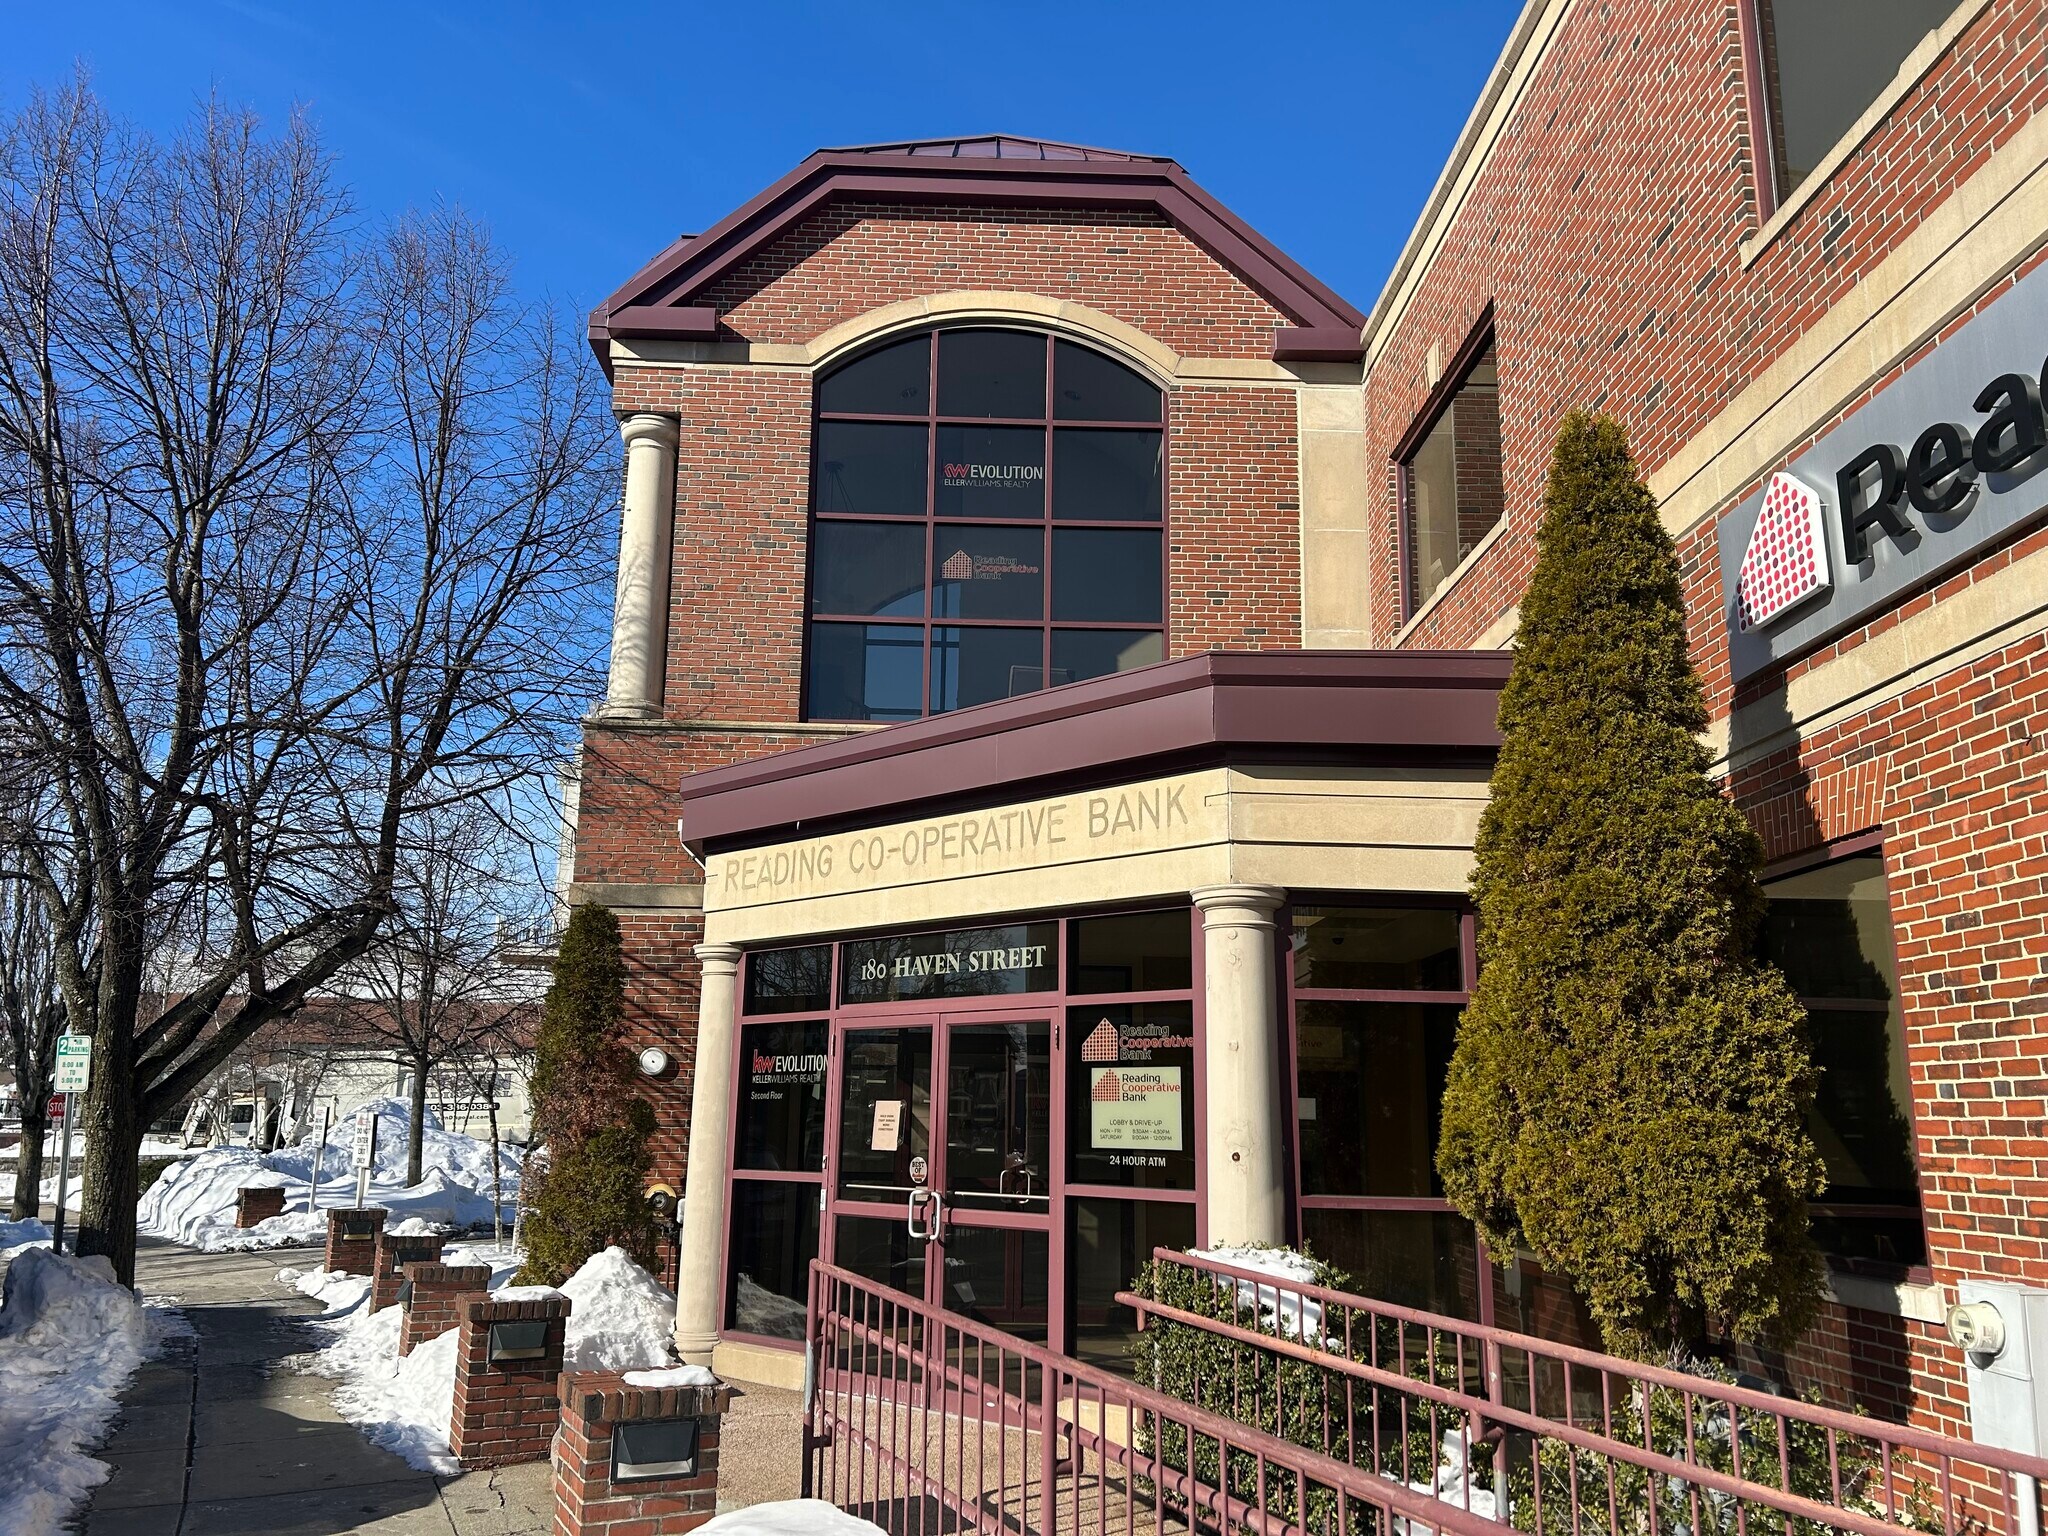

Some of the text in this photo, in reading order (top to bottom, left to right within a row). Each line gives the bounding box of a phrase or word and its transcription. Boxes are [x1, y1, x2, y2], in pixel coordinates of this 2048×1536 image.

[1836, 352, 2048, 567] Rea
[970, 464, 1043, 480] EVOLUTION
[1003, 480, 1031, 489] REALTY
[973, 555, 1018, 566] Reading
[973, 564, 1039, 574] Cooperative
[973, 572, 1002, 580] Bank
[725, 783, 1189, 893] READING CO-OPERATIVE BANK
[861, 945, 1047, 981] 180 HAVEN STREET
[1119, 1023, 1170, 1037] Reading
[60, 1039, 68, 1053] 2
[1118, 1034, 1194, 1049] Cooperative
[1119, 1048, 1152, 1061] Bank
[1121, 1073, 1161, 1084] Reading
[1121, 1082, 1180, 1095] Cooperative
[750, 1091, 783, 1100] Second Floor
[1121, 1092, 1147, 1102] Bank
[1109, 1155, 1166, 1167] 24 HOUR ATM
